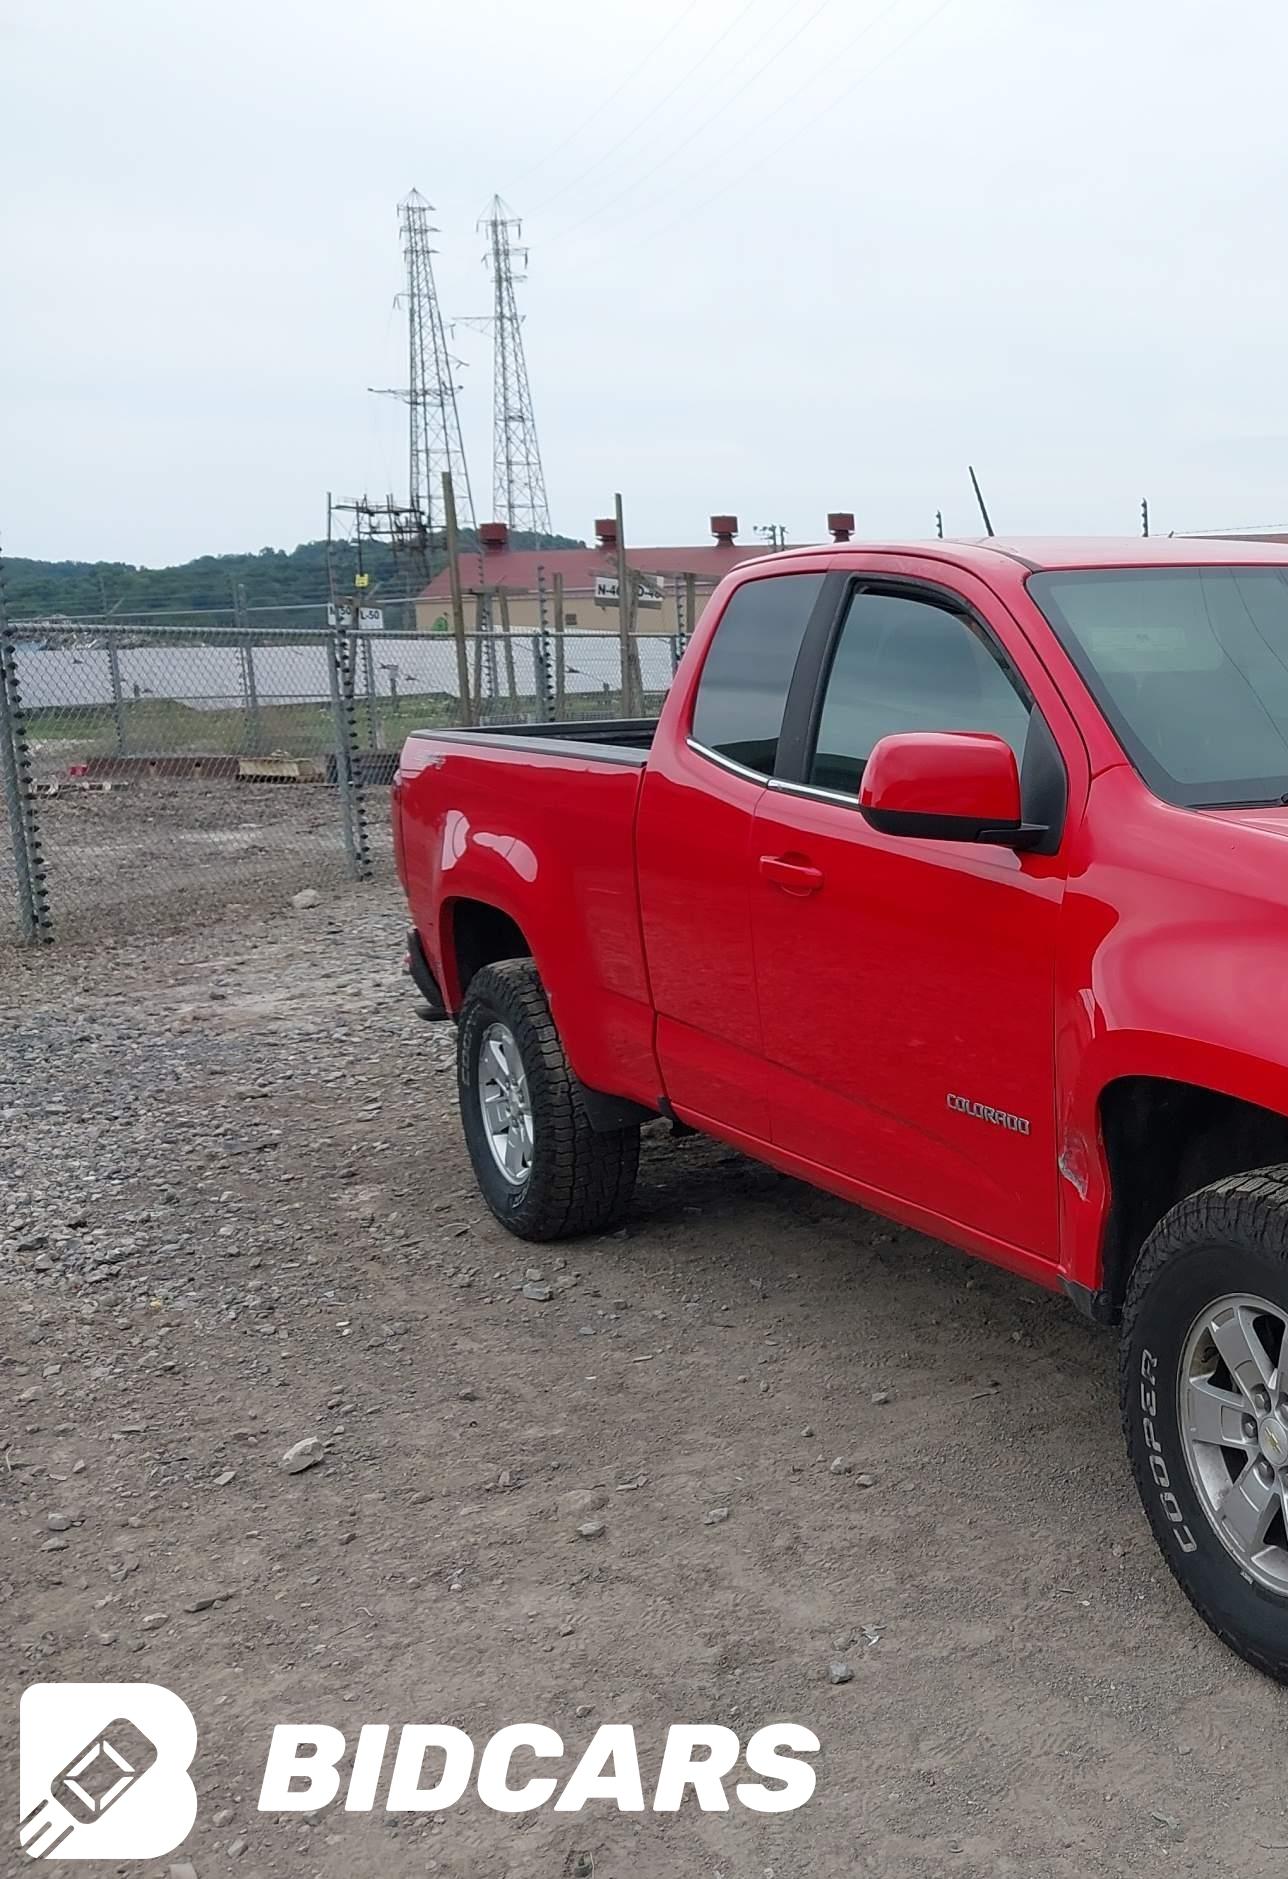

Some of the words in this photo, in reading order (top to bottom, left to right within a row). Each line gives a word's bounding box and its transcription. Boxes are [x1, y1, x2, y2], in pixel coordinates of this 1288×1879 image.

[360, 609, 380, 620] L-50
[946, 1093, 1030, 1136] COLORADO
[1140, 1349, 1199, 1553] COOPER
